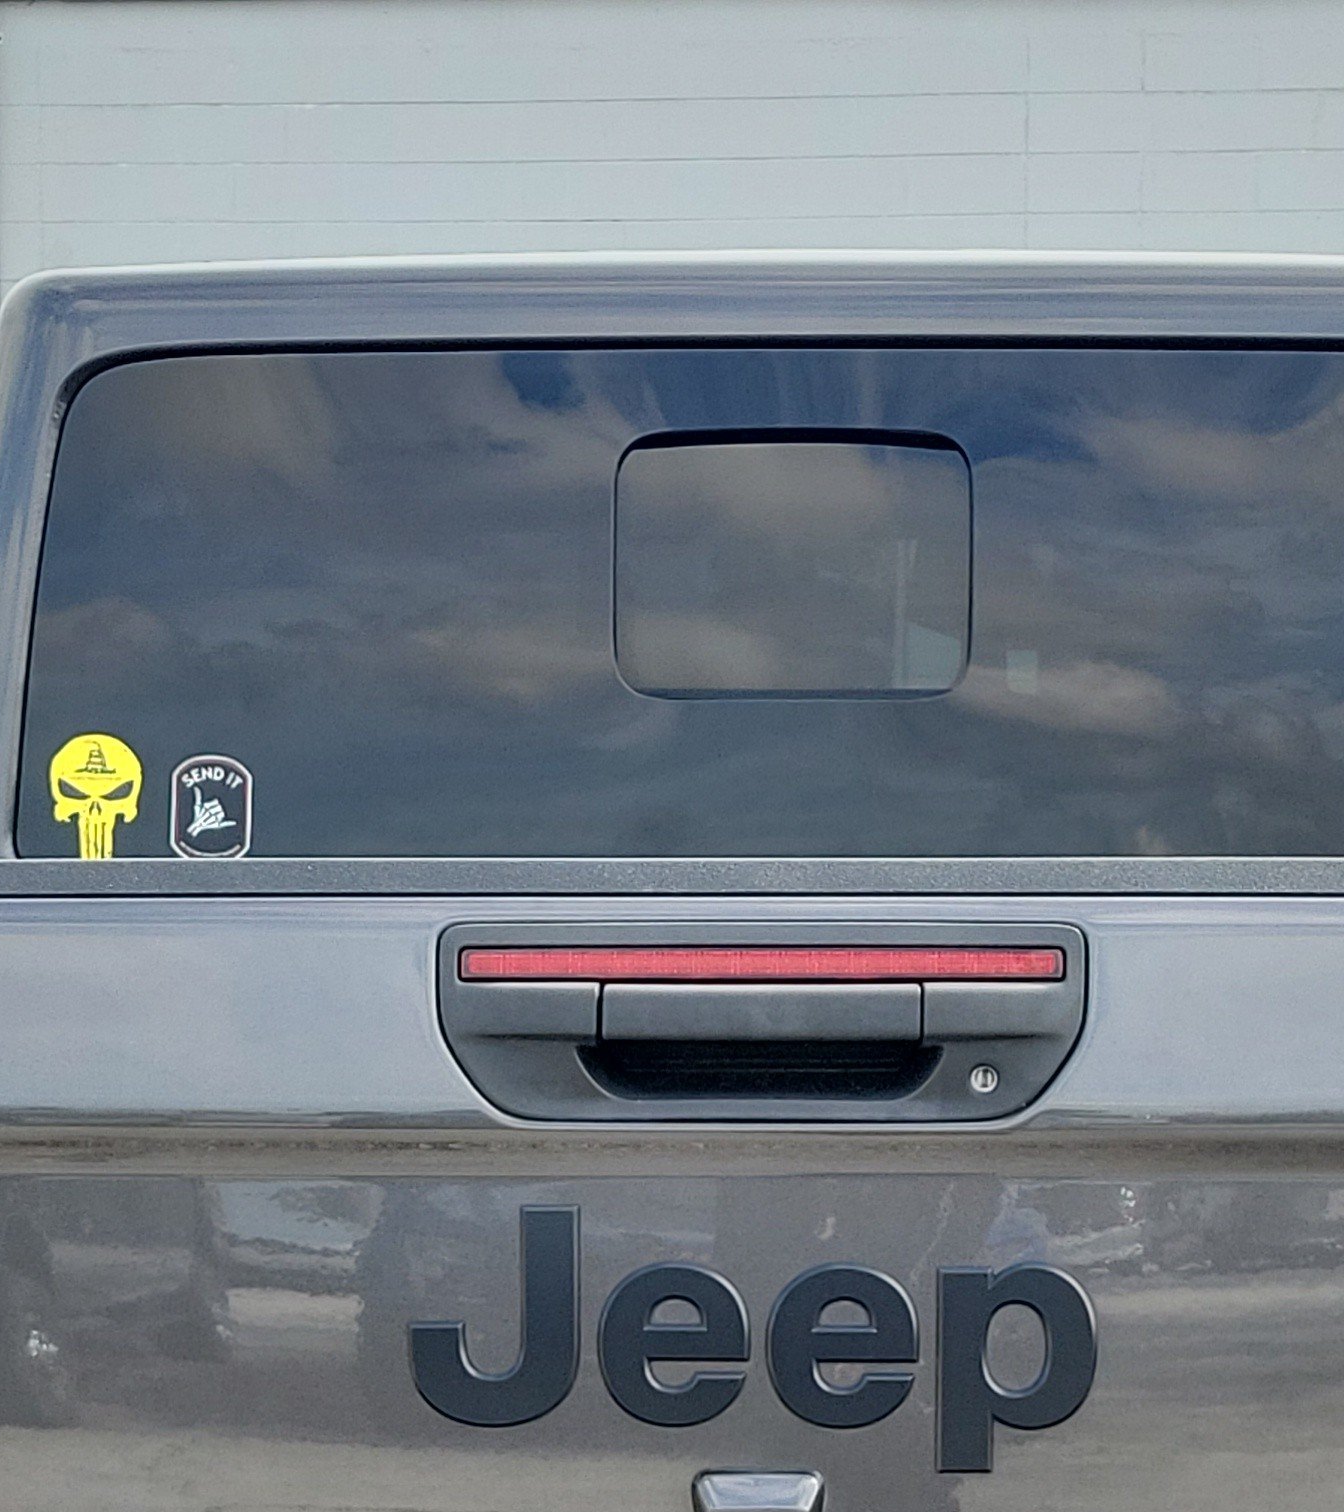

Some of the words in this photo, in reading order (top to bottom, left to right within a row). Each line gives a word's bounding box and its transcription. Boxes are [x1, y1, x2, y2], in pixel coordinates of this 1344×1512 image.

[181, 766, 225, 788] SEND
[225, 771, 243, 789] IT
[408, 1205, 1098, 1474] Jeep
